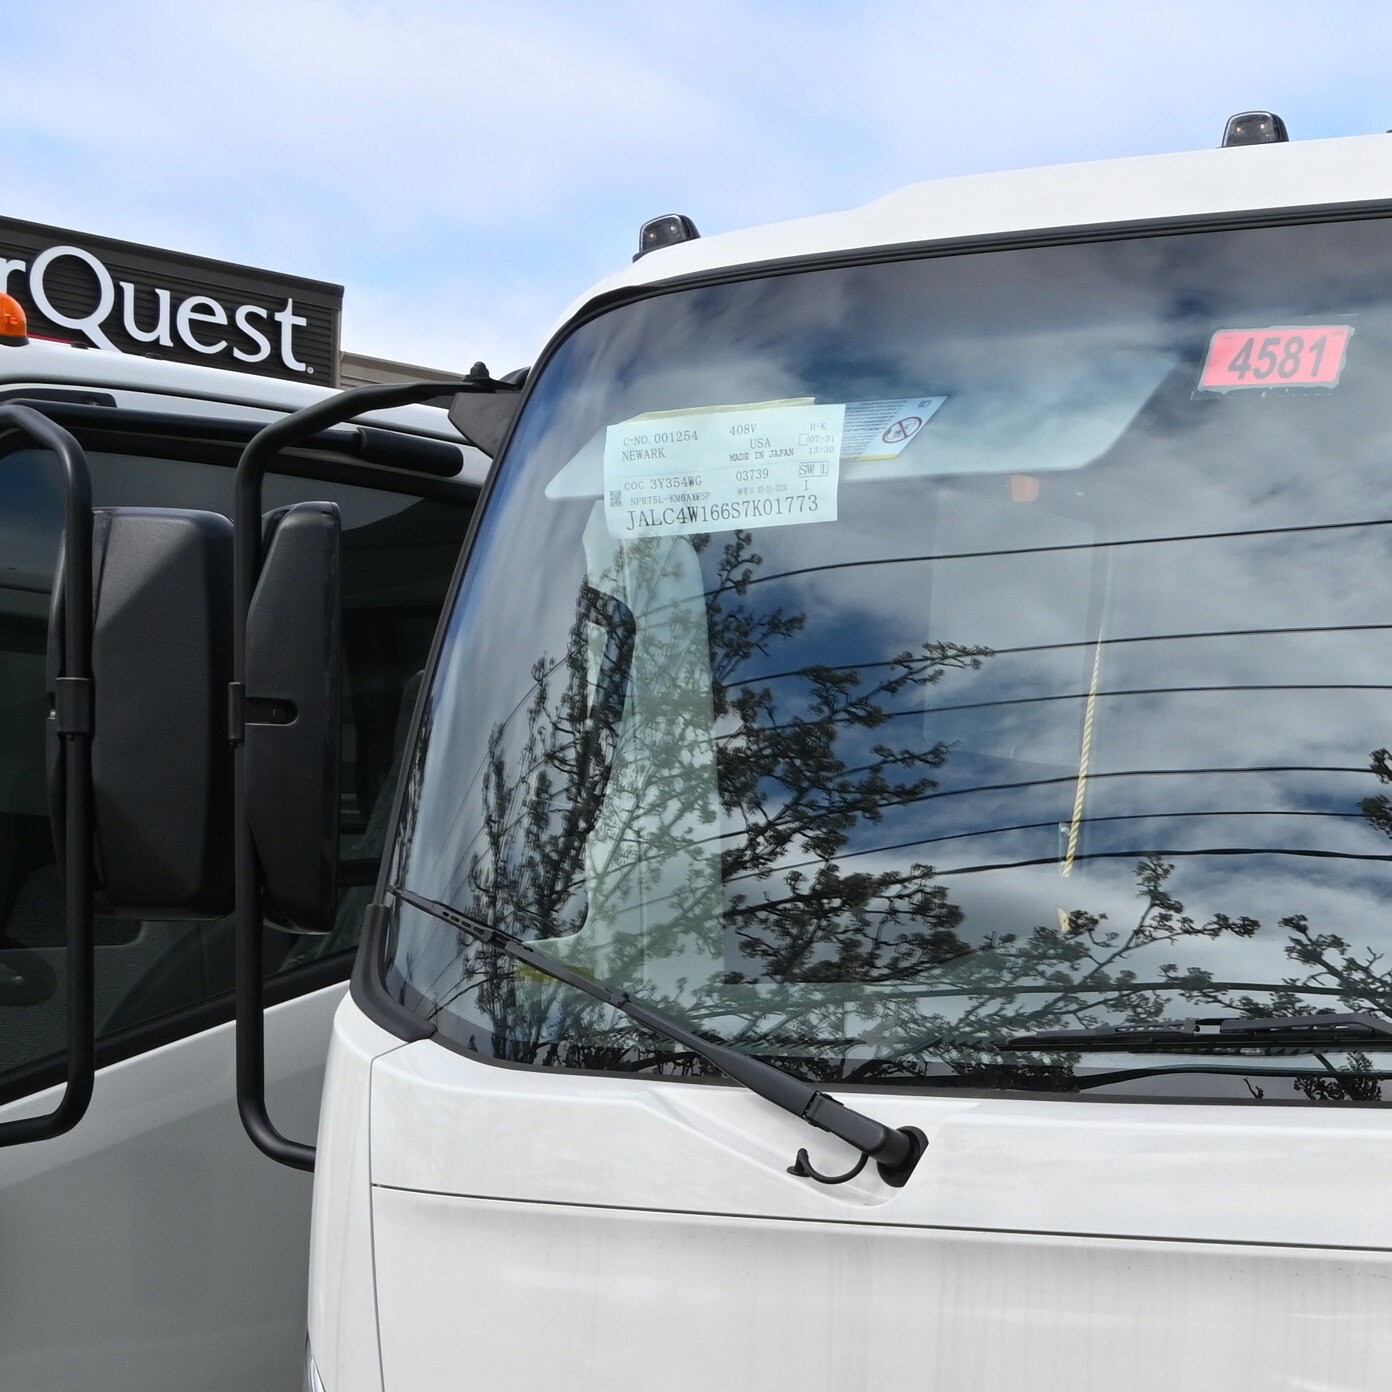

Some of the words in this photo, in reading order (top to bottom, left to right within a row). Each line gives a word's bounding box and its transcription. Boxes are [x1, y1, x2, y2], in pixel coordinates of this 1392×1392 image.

[1228, 335, 1328, 380] 4581
[729, 423, 757, 436] 408V
[654, 430, 699, 444] 001254
[750, 438, 771, 449] USA
[622, 448, 666, 461] NEWARK
[729, 452, 750, 462] MADE
[755, 451, 765, 460] IN
[769, 448, 795, 458] JAPAN
[736, 468, 769, 481] 03739
[651, 475, 702, 490] 3Y354WG
